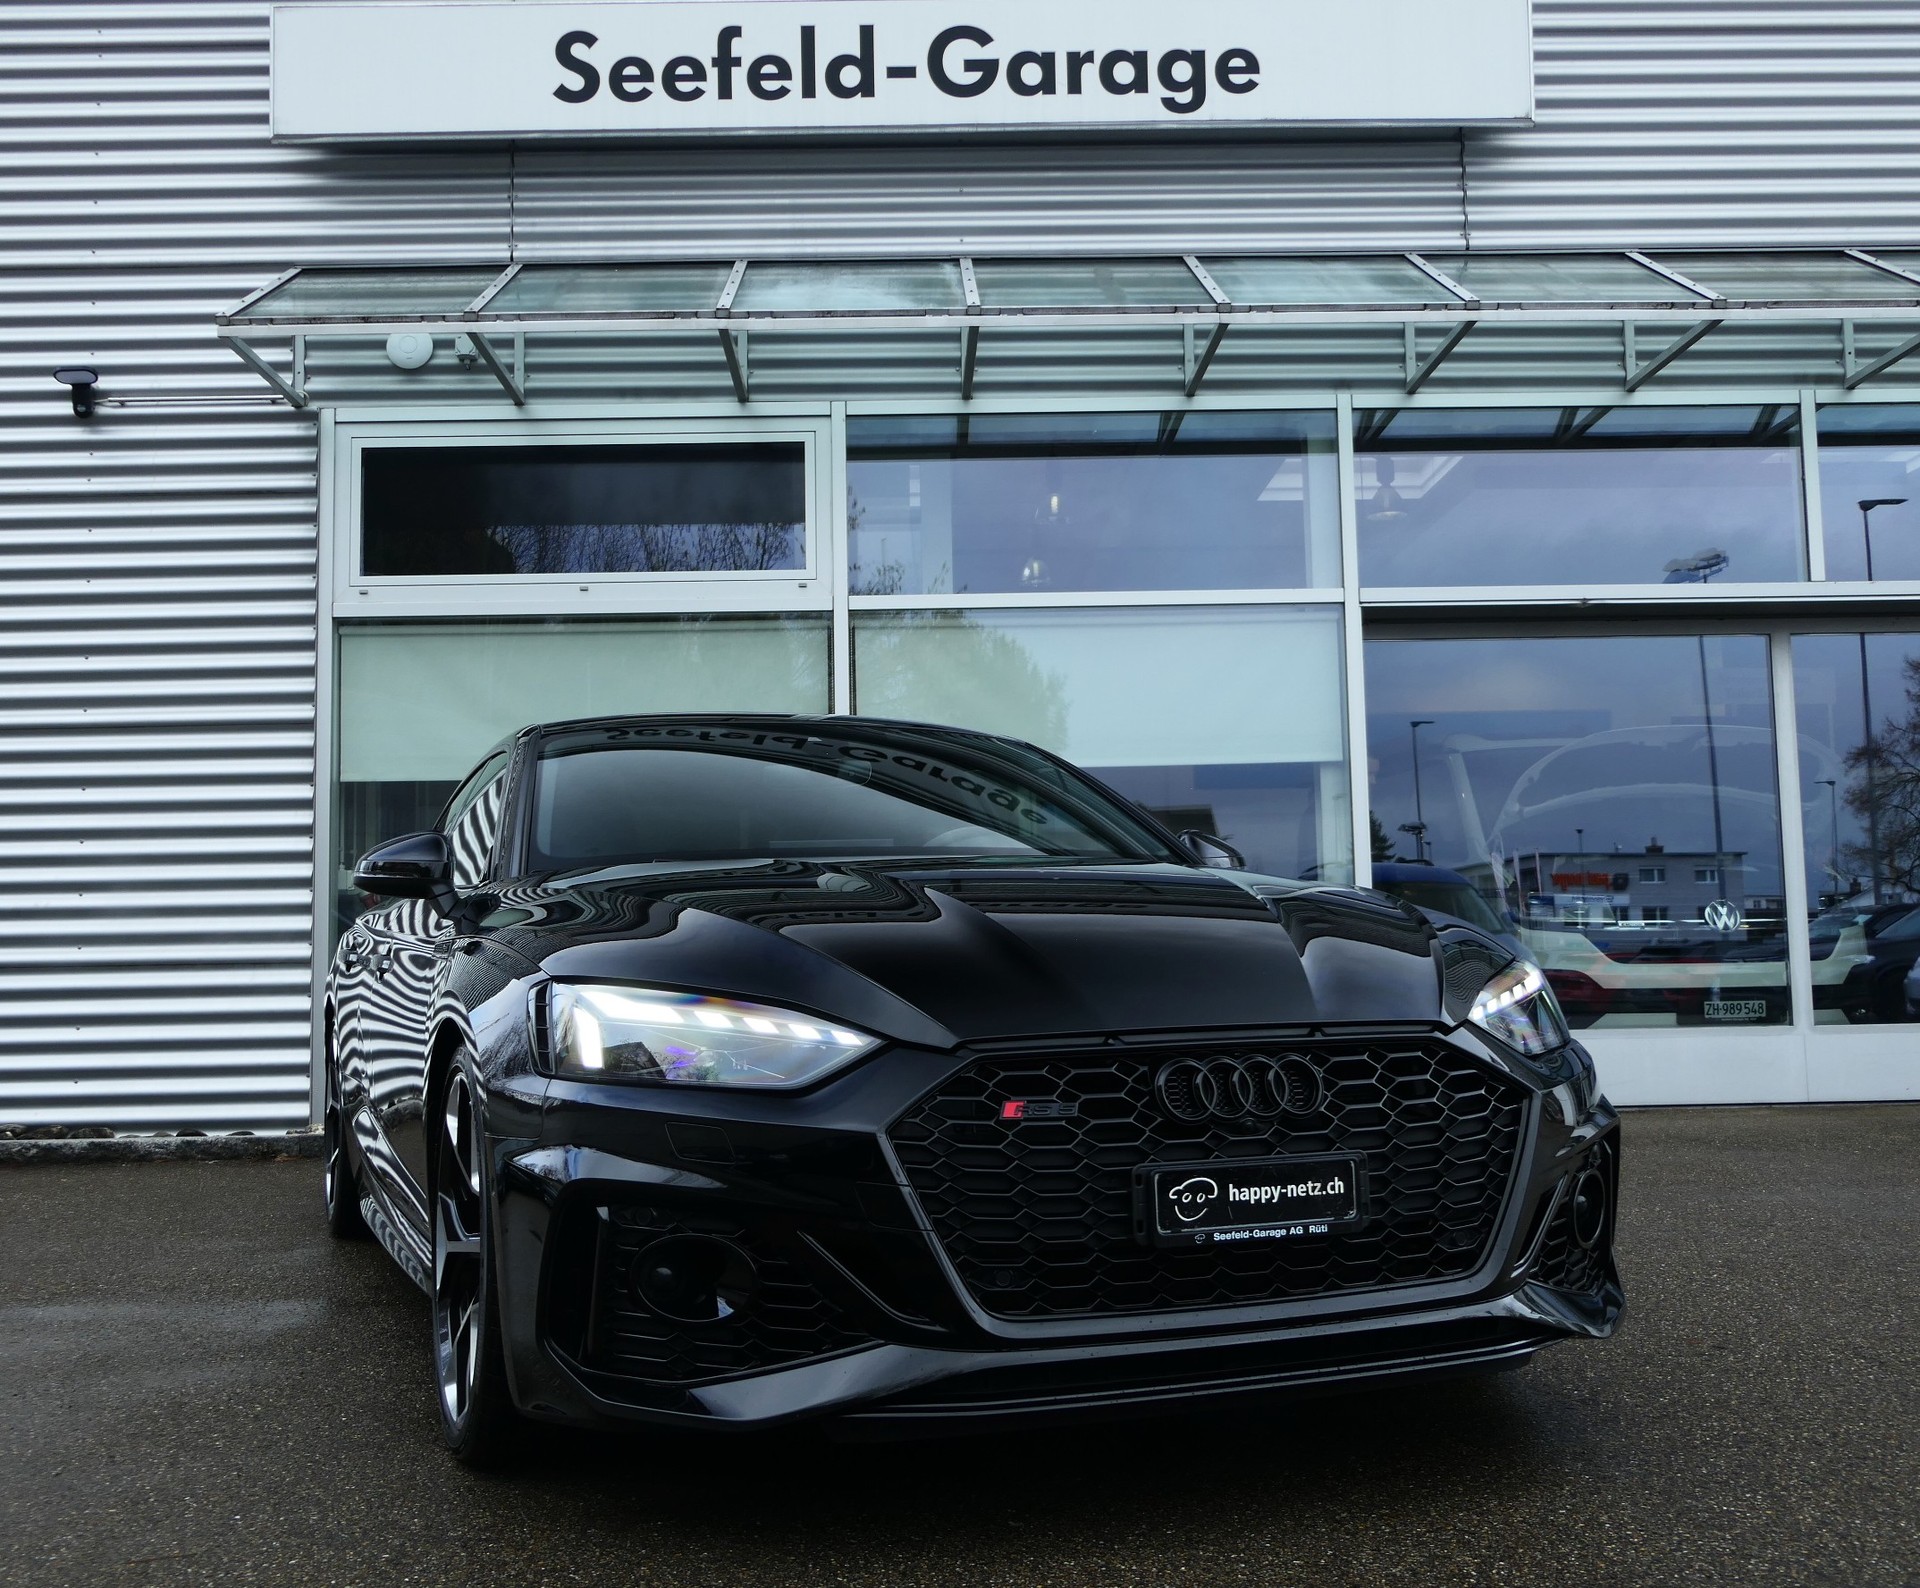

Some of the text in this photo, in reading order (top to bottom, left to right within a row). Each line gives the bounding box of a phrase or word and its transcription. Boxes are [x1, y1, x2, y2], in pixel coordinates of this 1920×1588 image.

[552, 25, 1261, 114] Seefeld-Garage
[1228, 1176, 1345, 1204] happy-netz.ch
[1213, 1224, 1328, 1241] Seefeld-Garage AG Rüti
